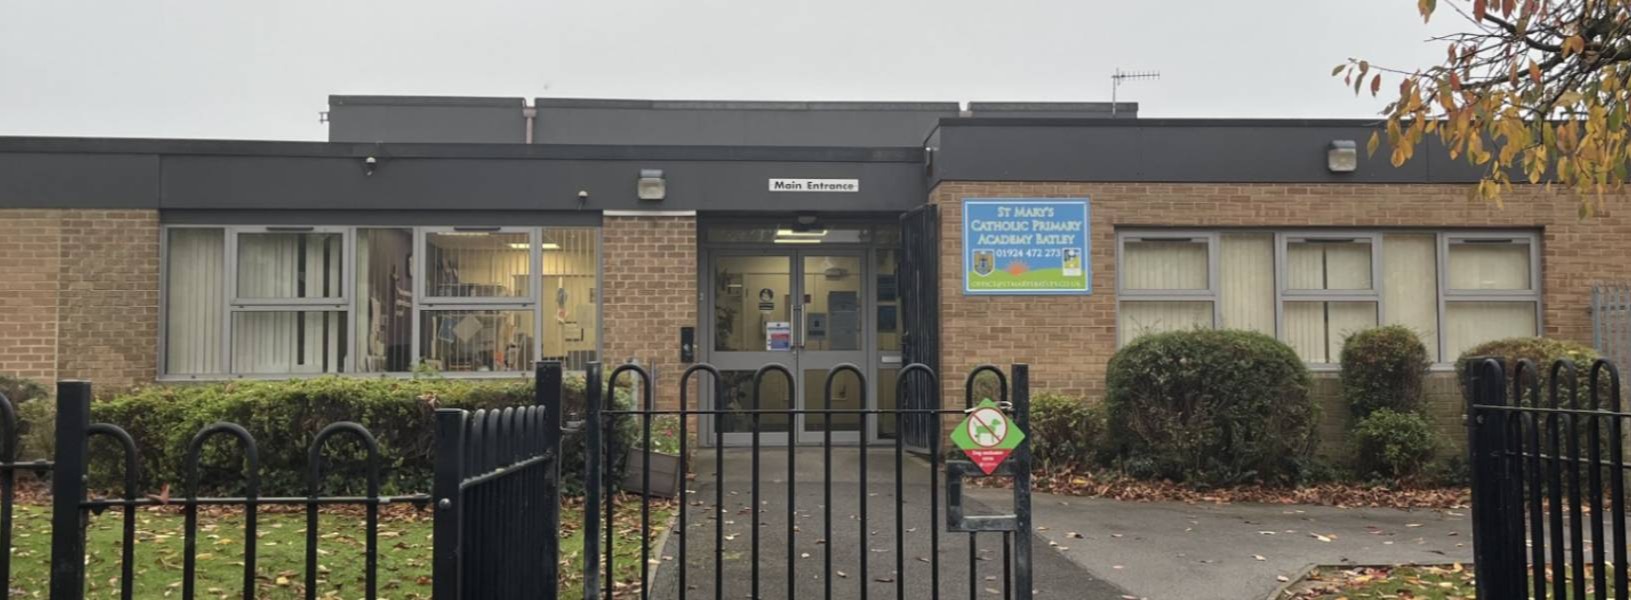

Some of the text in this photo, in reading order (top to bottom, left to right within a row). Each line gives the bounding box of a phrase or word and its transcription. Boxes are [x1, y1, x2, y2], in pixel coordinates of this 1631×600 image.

[774, 181, 855, 190] Main Entrance
[971, 220, 1082, 231] CATHOLIC PRIMARY
[978, 234, 1075, 245] ACADEMY BATLEY
[996, 249, 1061, 257] 01924 472 273
